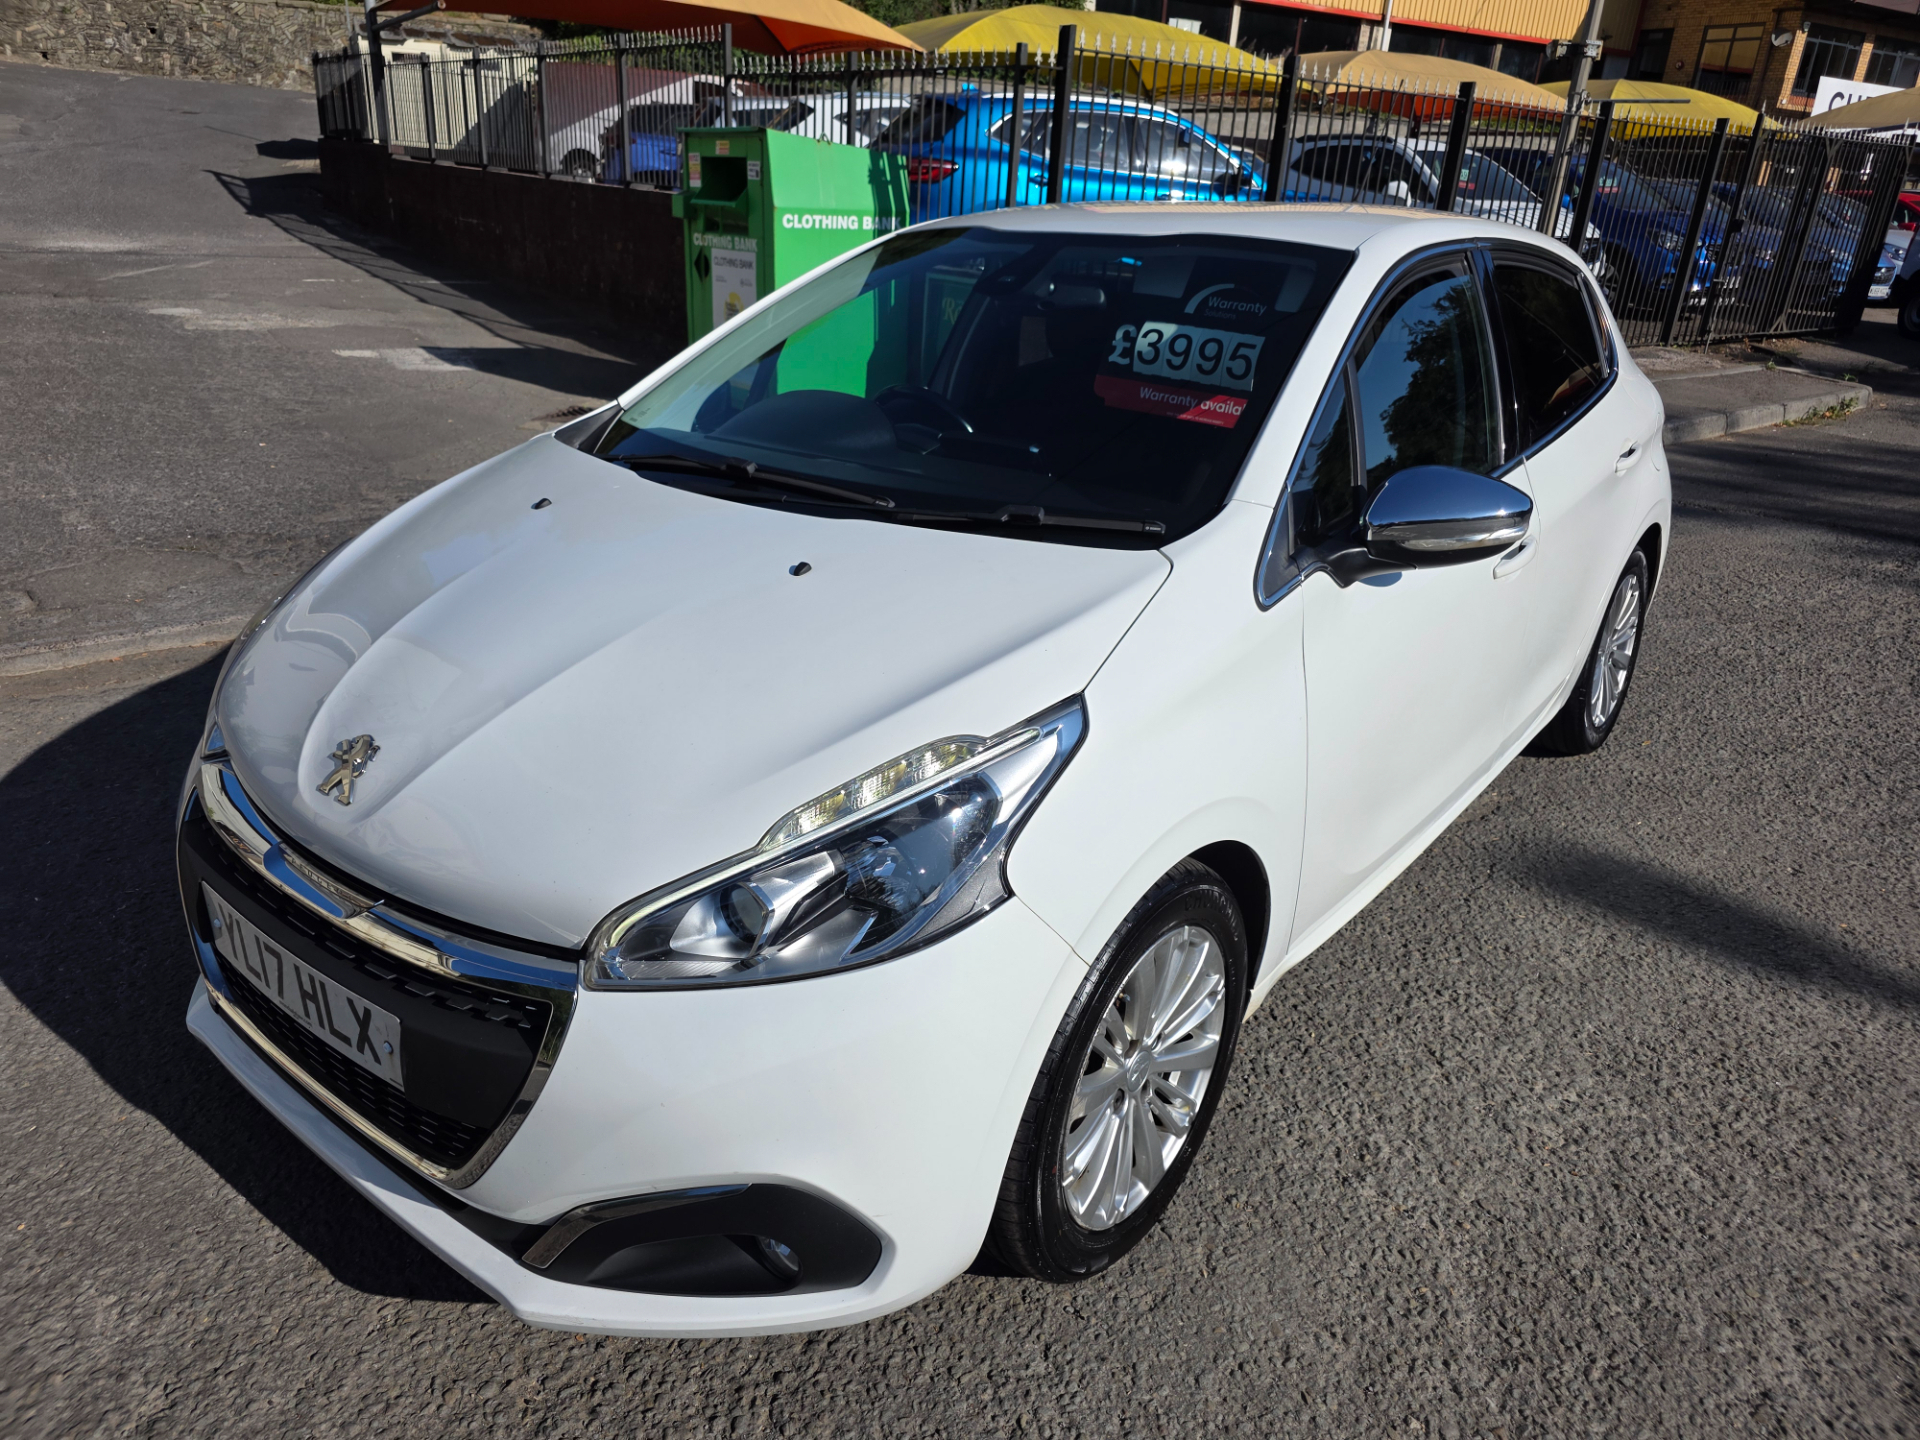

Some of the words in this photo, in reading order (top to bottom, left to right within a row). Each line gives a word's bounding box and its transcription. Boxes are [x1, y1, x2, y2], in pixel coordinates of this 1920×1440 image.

[782, 213, 859, 230] CLOTHING
[862, 215, 902, 231] BANK
[693, 232, 732, 249] CLOTHING
[734, 236, 758, 252] BANK
[713, 256, 739, 269] CLOTHING
[739, 258, 755, 270] BANK
[1204, 308, 1237, 320] Solutions
[1208, 296, 1267, 316] Warranty
[1108, 324, 1257, 380] £3995
[1139, 386, 1199, 411] Warranty
[218, 902, 284, 1000] YL17
[293, 962, 382, 1066] HLX
